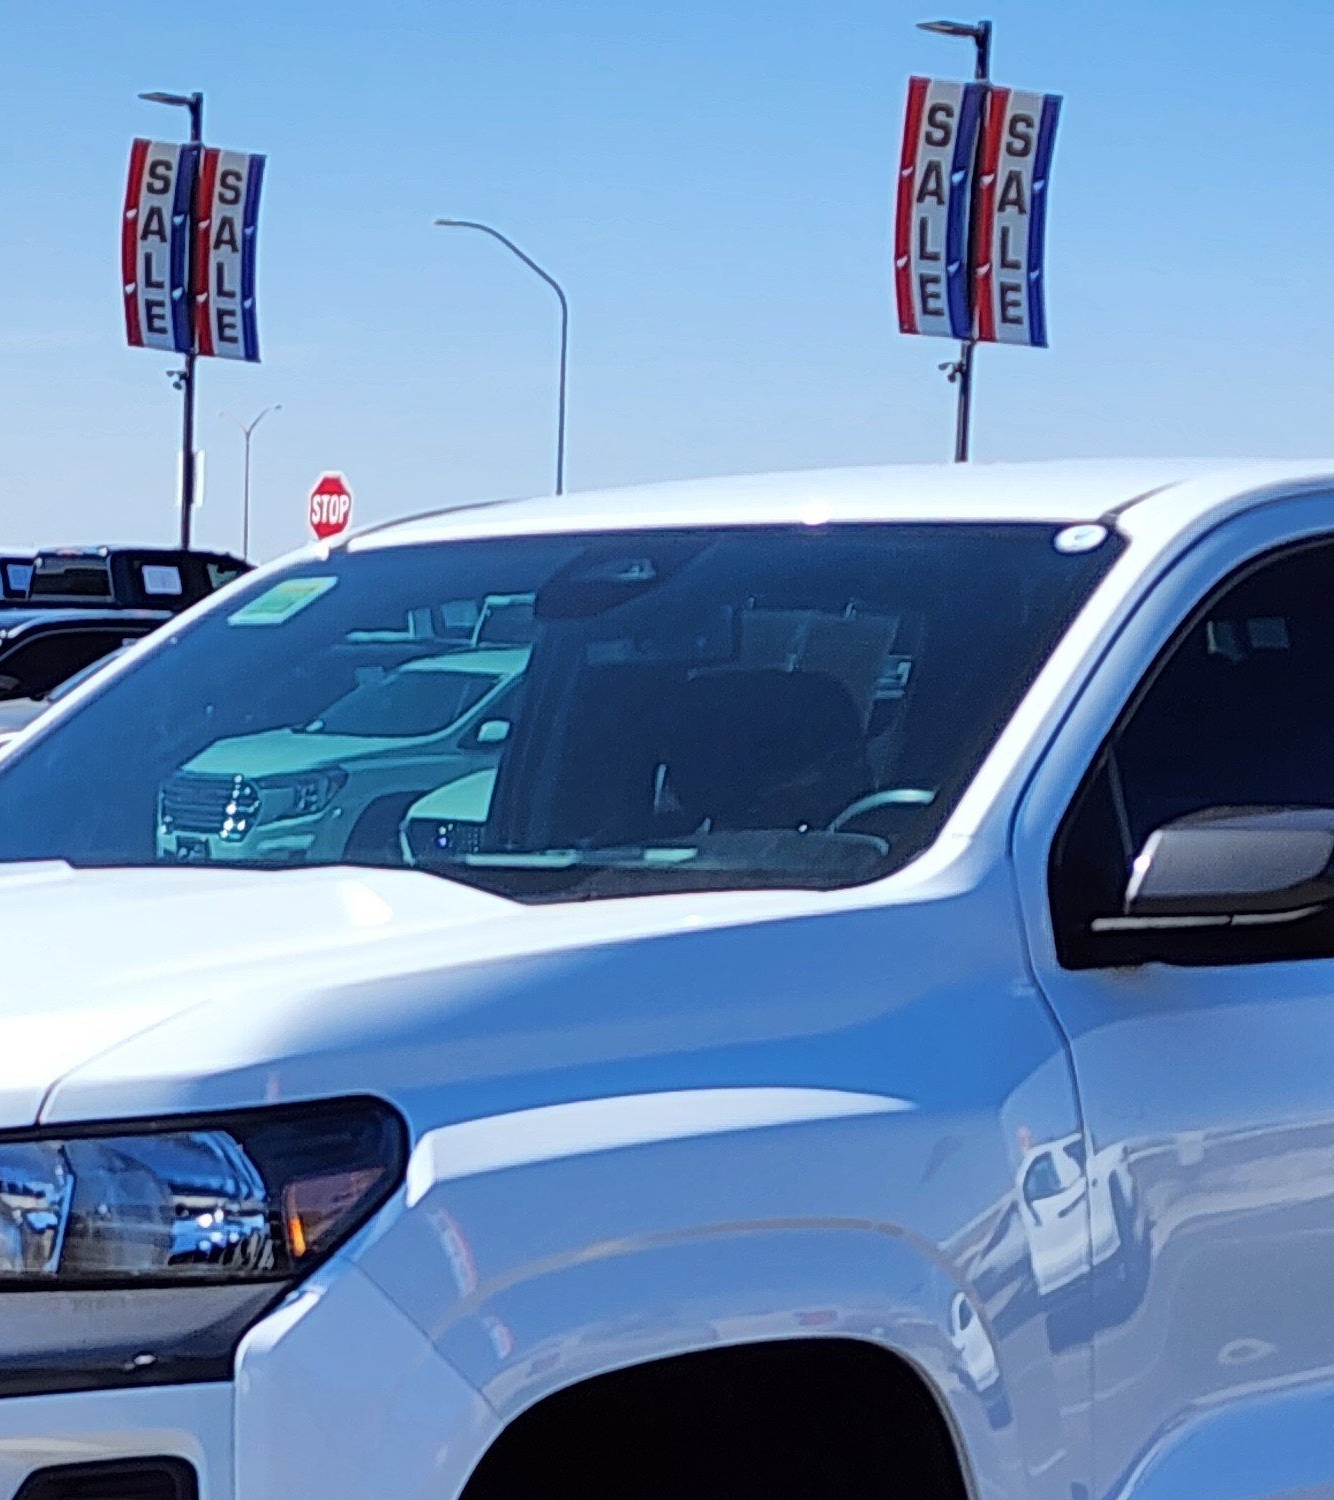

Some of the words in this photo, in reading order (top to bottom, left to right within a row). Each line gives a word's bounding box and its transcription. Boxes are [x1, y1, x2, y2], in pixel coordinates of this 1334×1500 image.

[140, 159, 174, 335] SALE
[213, 169, 243, 344] SALE
[916, 102, 955, 317] SALE
[996, 113, 1035, 325] SALE
[311, 494, 349, 524] STOP
